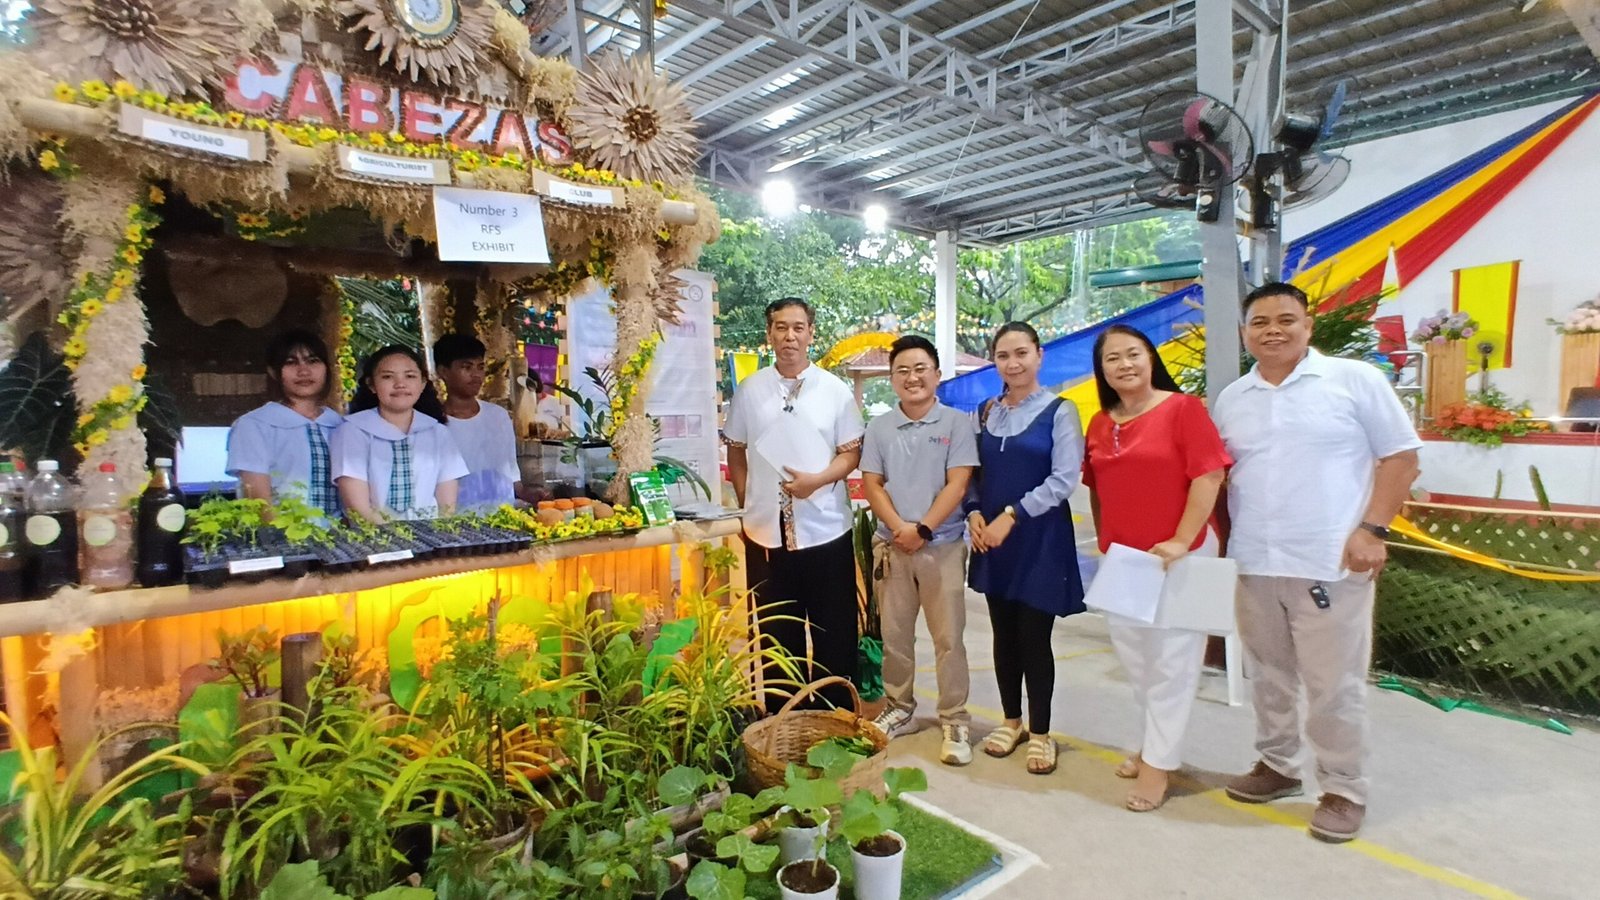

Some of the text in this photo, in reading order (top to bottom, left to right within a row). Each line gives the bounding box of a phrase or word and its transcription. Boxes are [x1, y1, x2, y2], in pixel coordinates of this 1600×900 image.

[224, 56, 573, 165] CABEZAS
[169, 127, 225, 147] YOUNG
[569, 188, 593, 198] CLUB
[459, 203, 518, 218] Number 3
[481, 224, 502, 235] RFS
[472, 241, 515, 252] EXHIBIT
